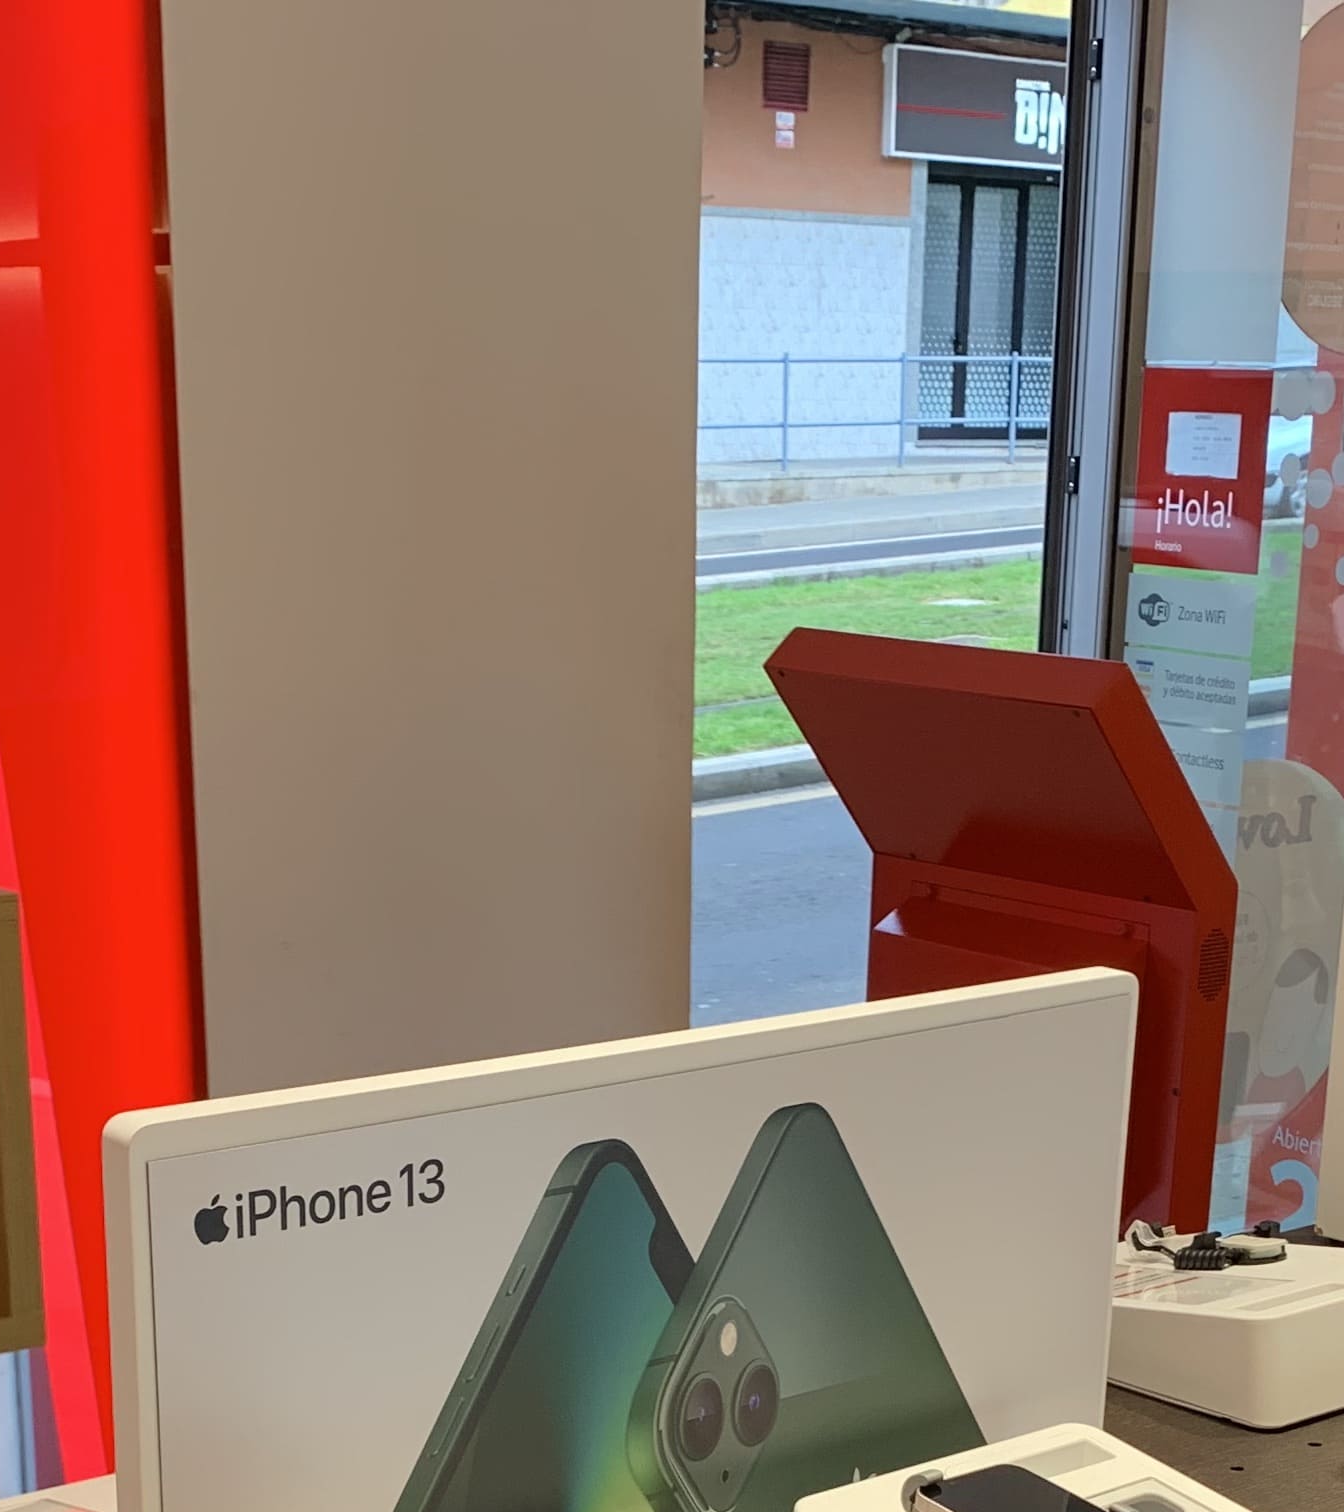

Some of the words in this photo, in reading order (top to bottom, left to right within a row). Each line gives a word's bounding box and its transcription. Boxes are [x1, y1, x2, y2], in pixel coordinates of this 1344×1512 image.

[1156, 487, 1234, 534] ¡Hola!
[1178, 605, 1204, 623] Zona
[234, 1178, 392, 1239] iPhone
[398, 1158, 446, 1208] 13
